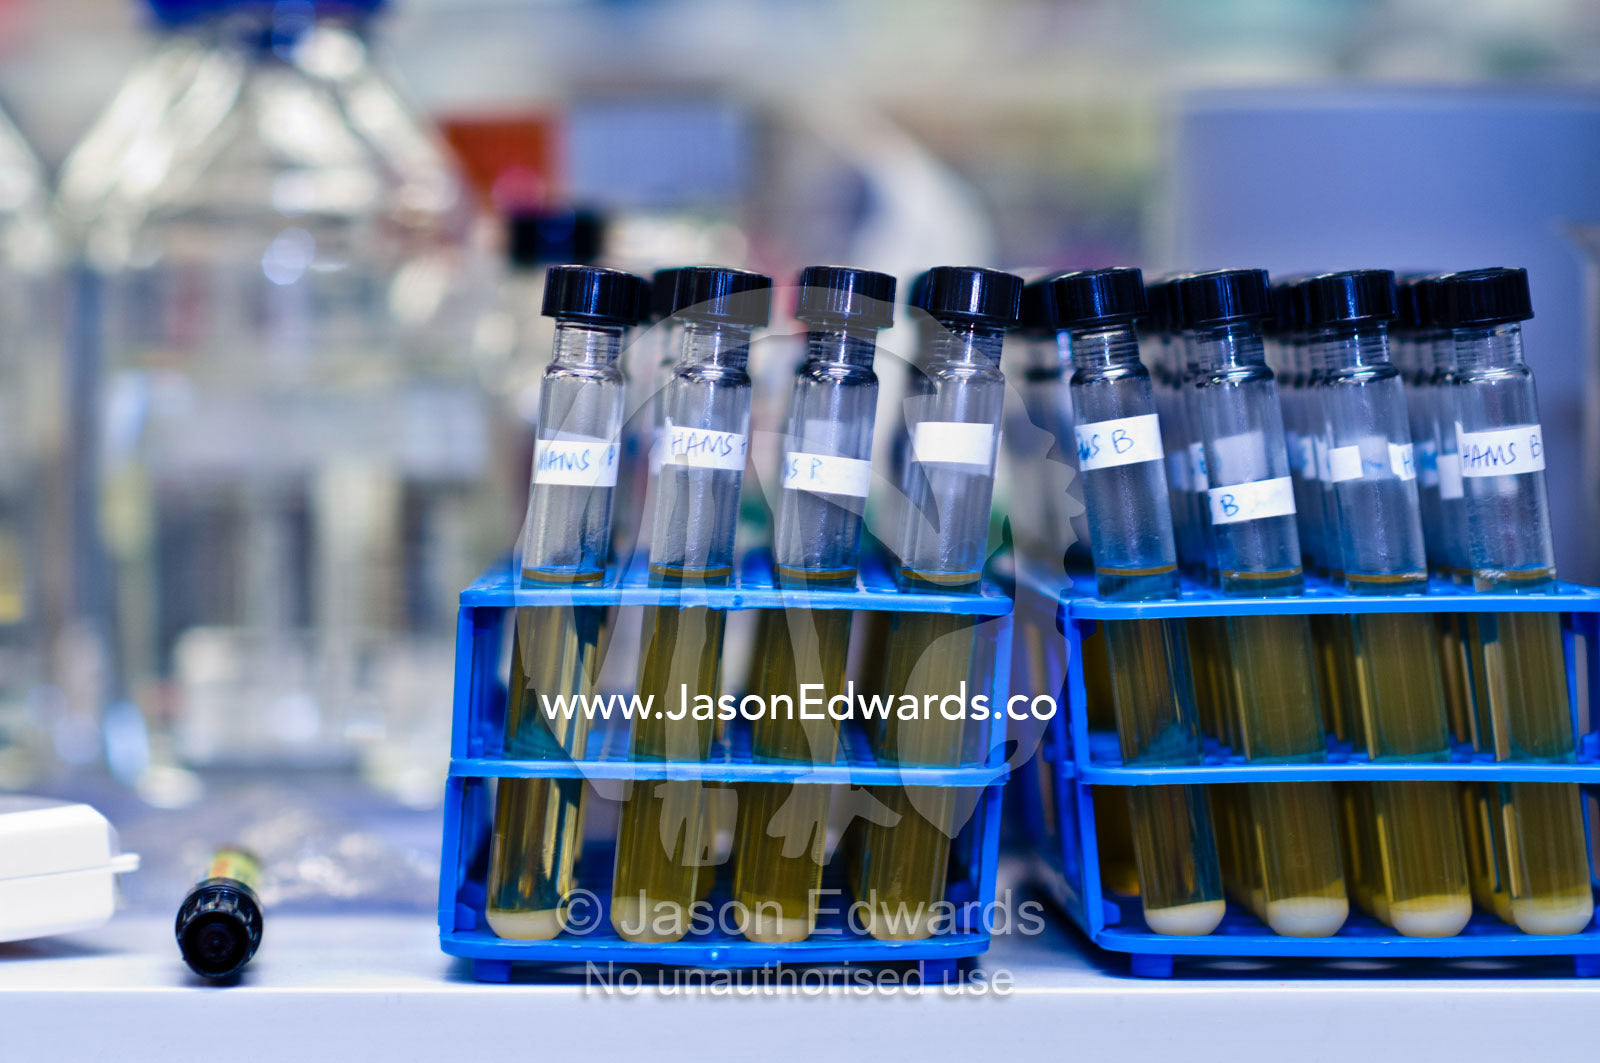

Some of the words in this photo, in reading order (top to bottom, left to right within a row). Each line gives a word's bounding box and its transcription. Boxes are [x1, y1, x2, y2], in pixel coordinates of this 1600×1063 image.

[672, 431, 733, 457] HAMS
[1112, 429, 1134, 454] B
[1220, 494, 1239, 517] B
